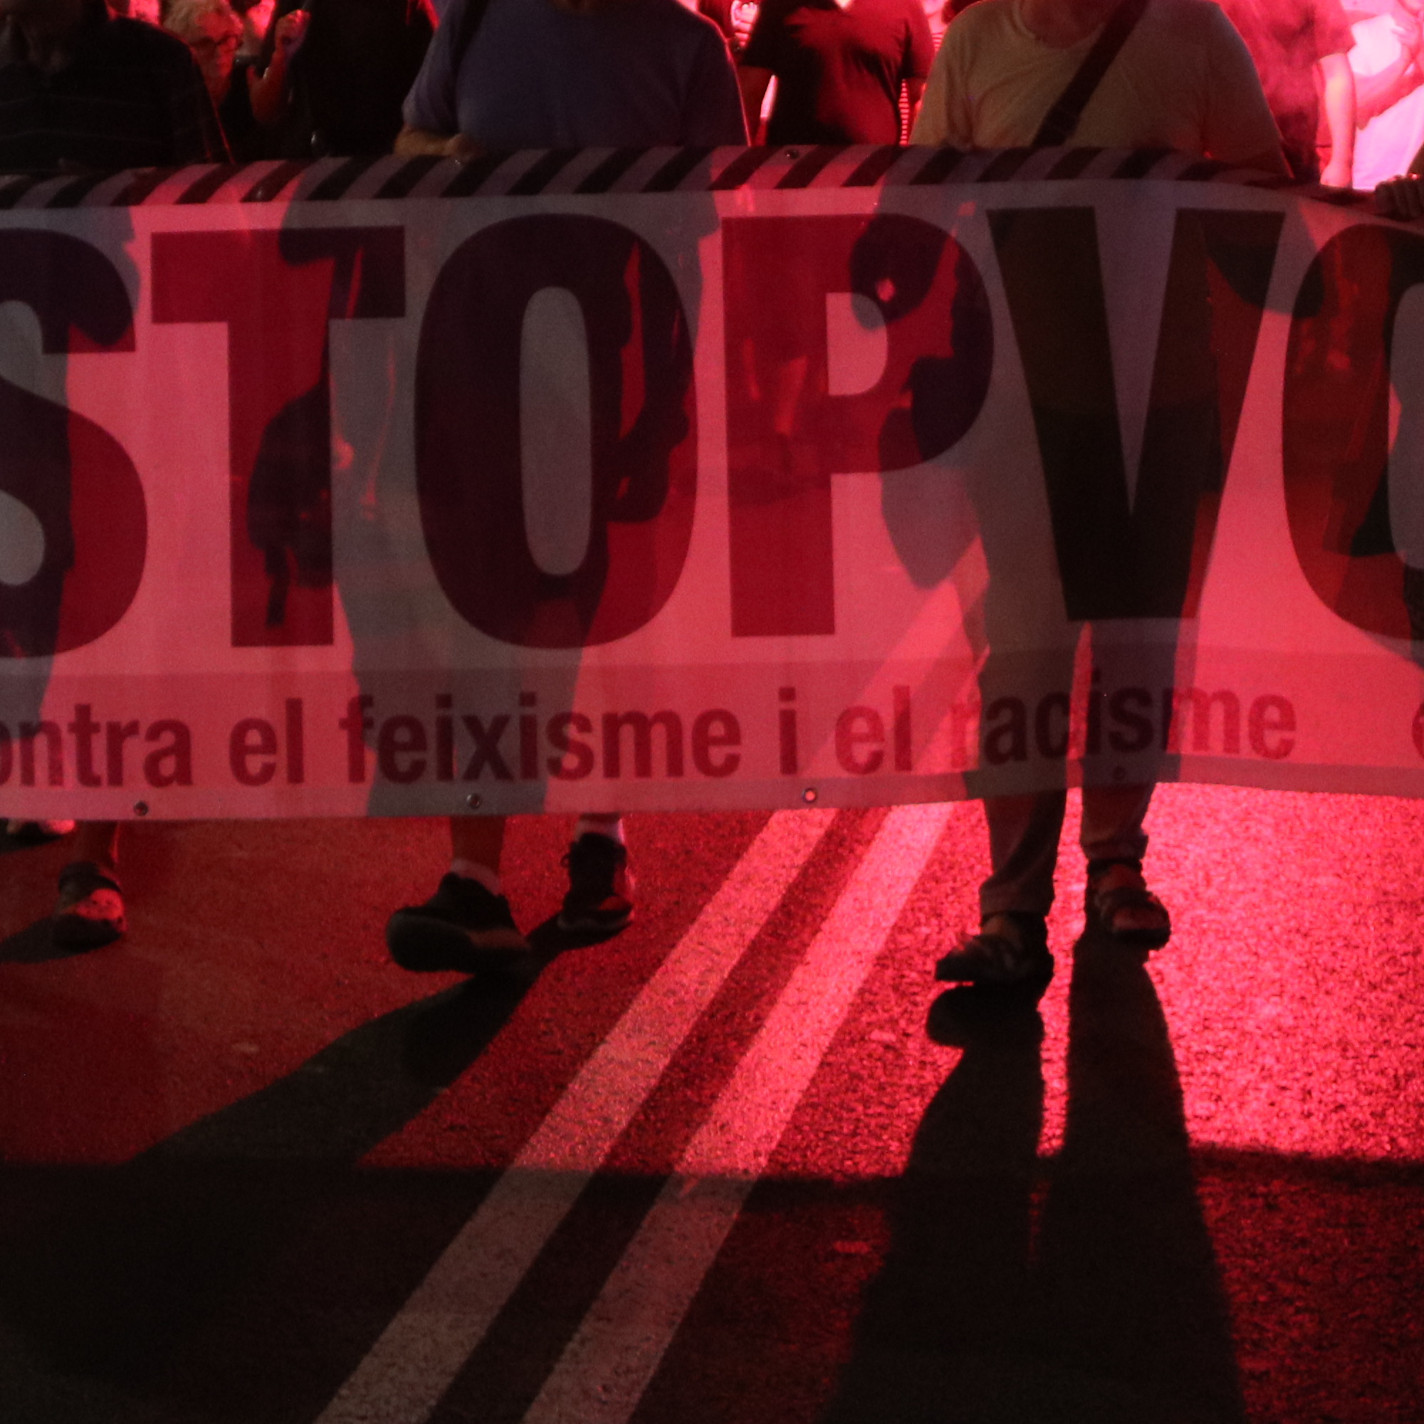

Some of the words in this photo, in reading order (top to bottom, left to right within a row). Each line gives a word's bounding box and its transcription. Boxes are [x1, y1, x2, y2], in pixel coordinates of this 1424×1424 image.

[229, 698, 305, 786] el
[339, 691, 744, 784] feixisme
[778, 688, 796, 775] i
[835, 685, 912, 773] el
[950, 669, 1296, 763] racisme
